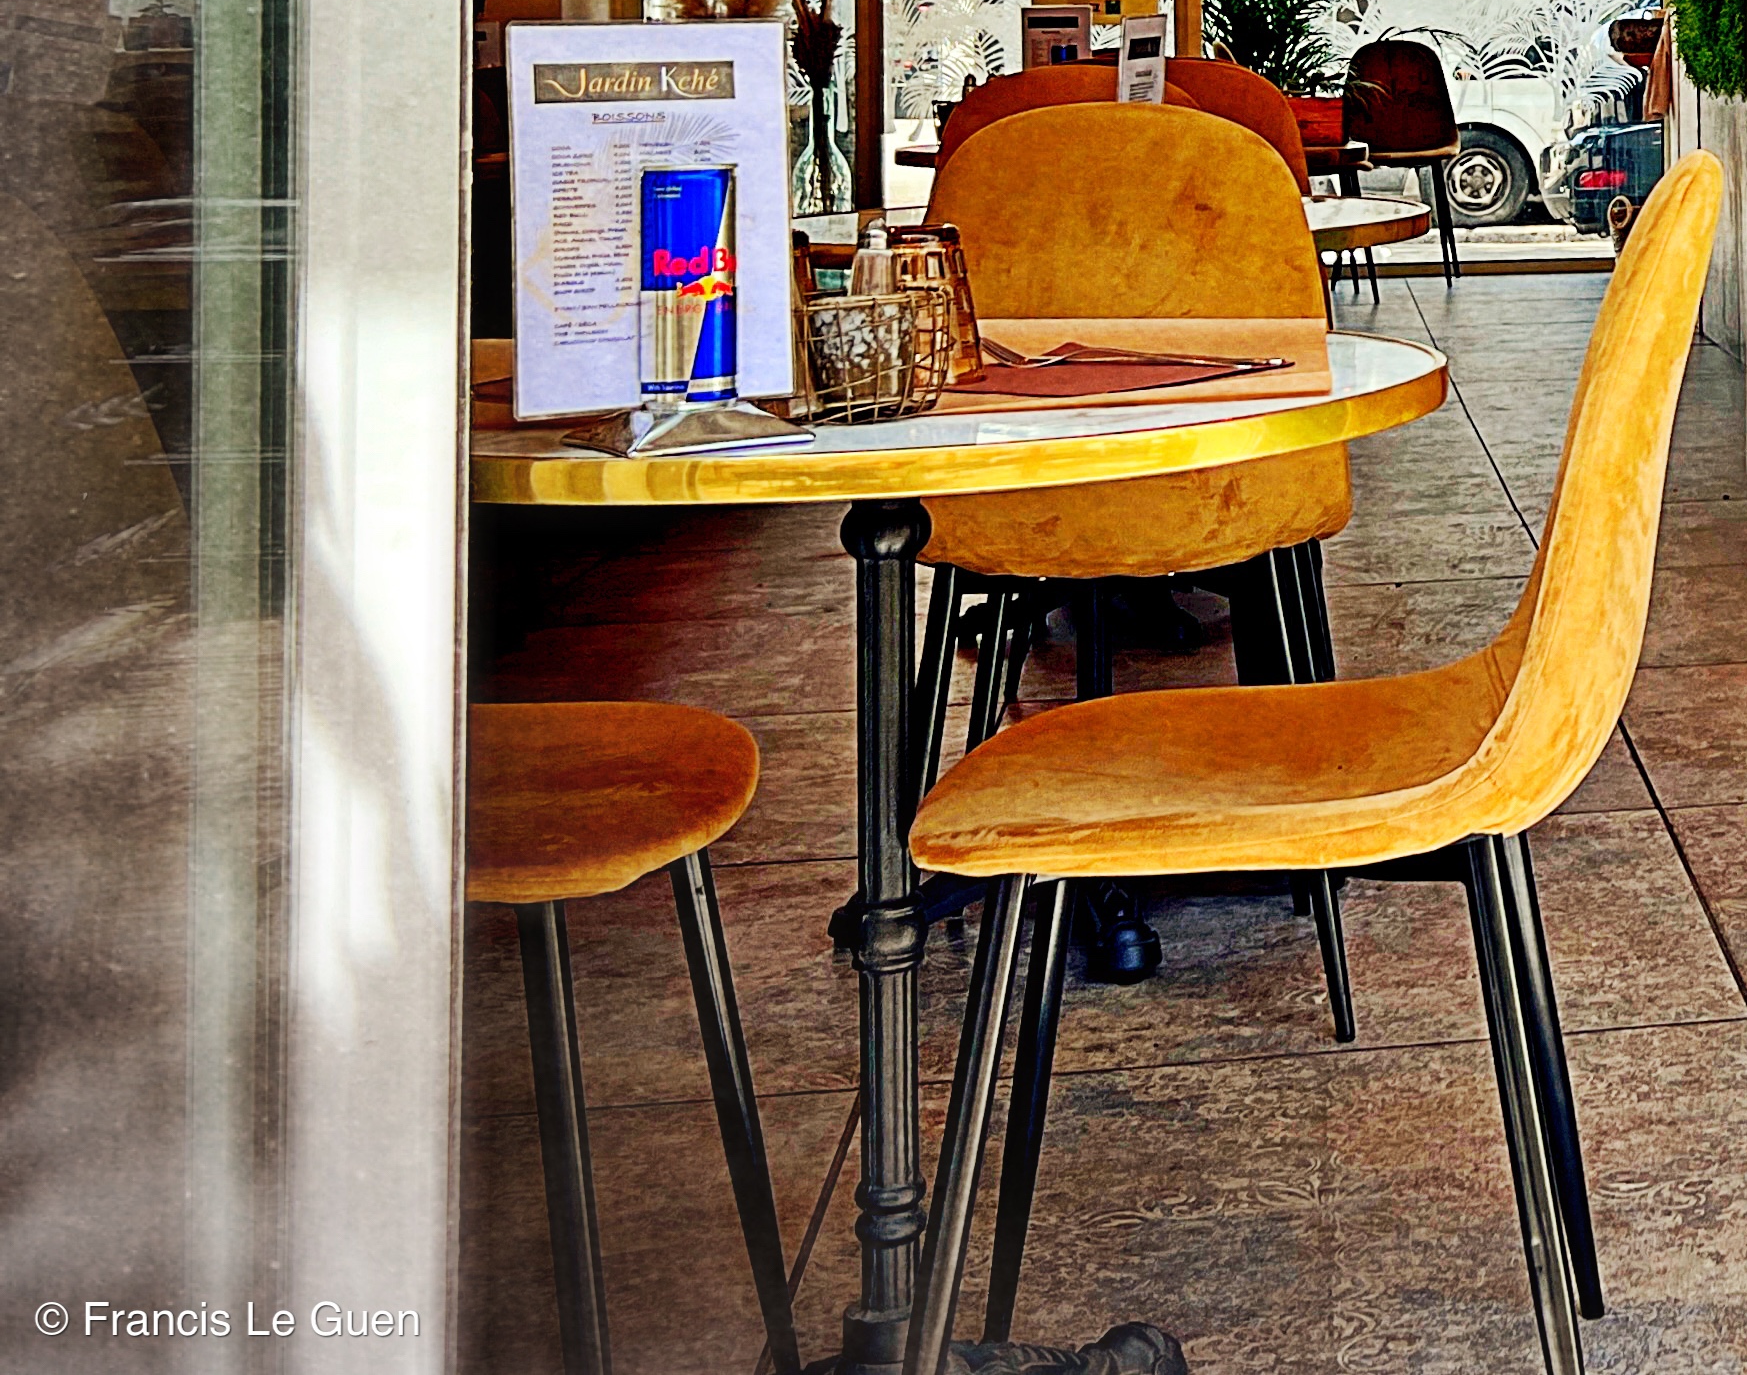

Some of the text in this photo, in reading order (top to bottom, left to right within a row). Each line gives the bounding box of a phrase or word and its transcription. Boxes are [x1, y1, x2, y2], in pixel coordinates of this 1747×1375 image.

[544, 66, 719, 99] Jardin Kché
[592, 111, 666, 122] BOISSONS
[653, 245, 709, 276] Red
